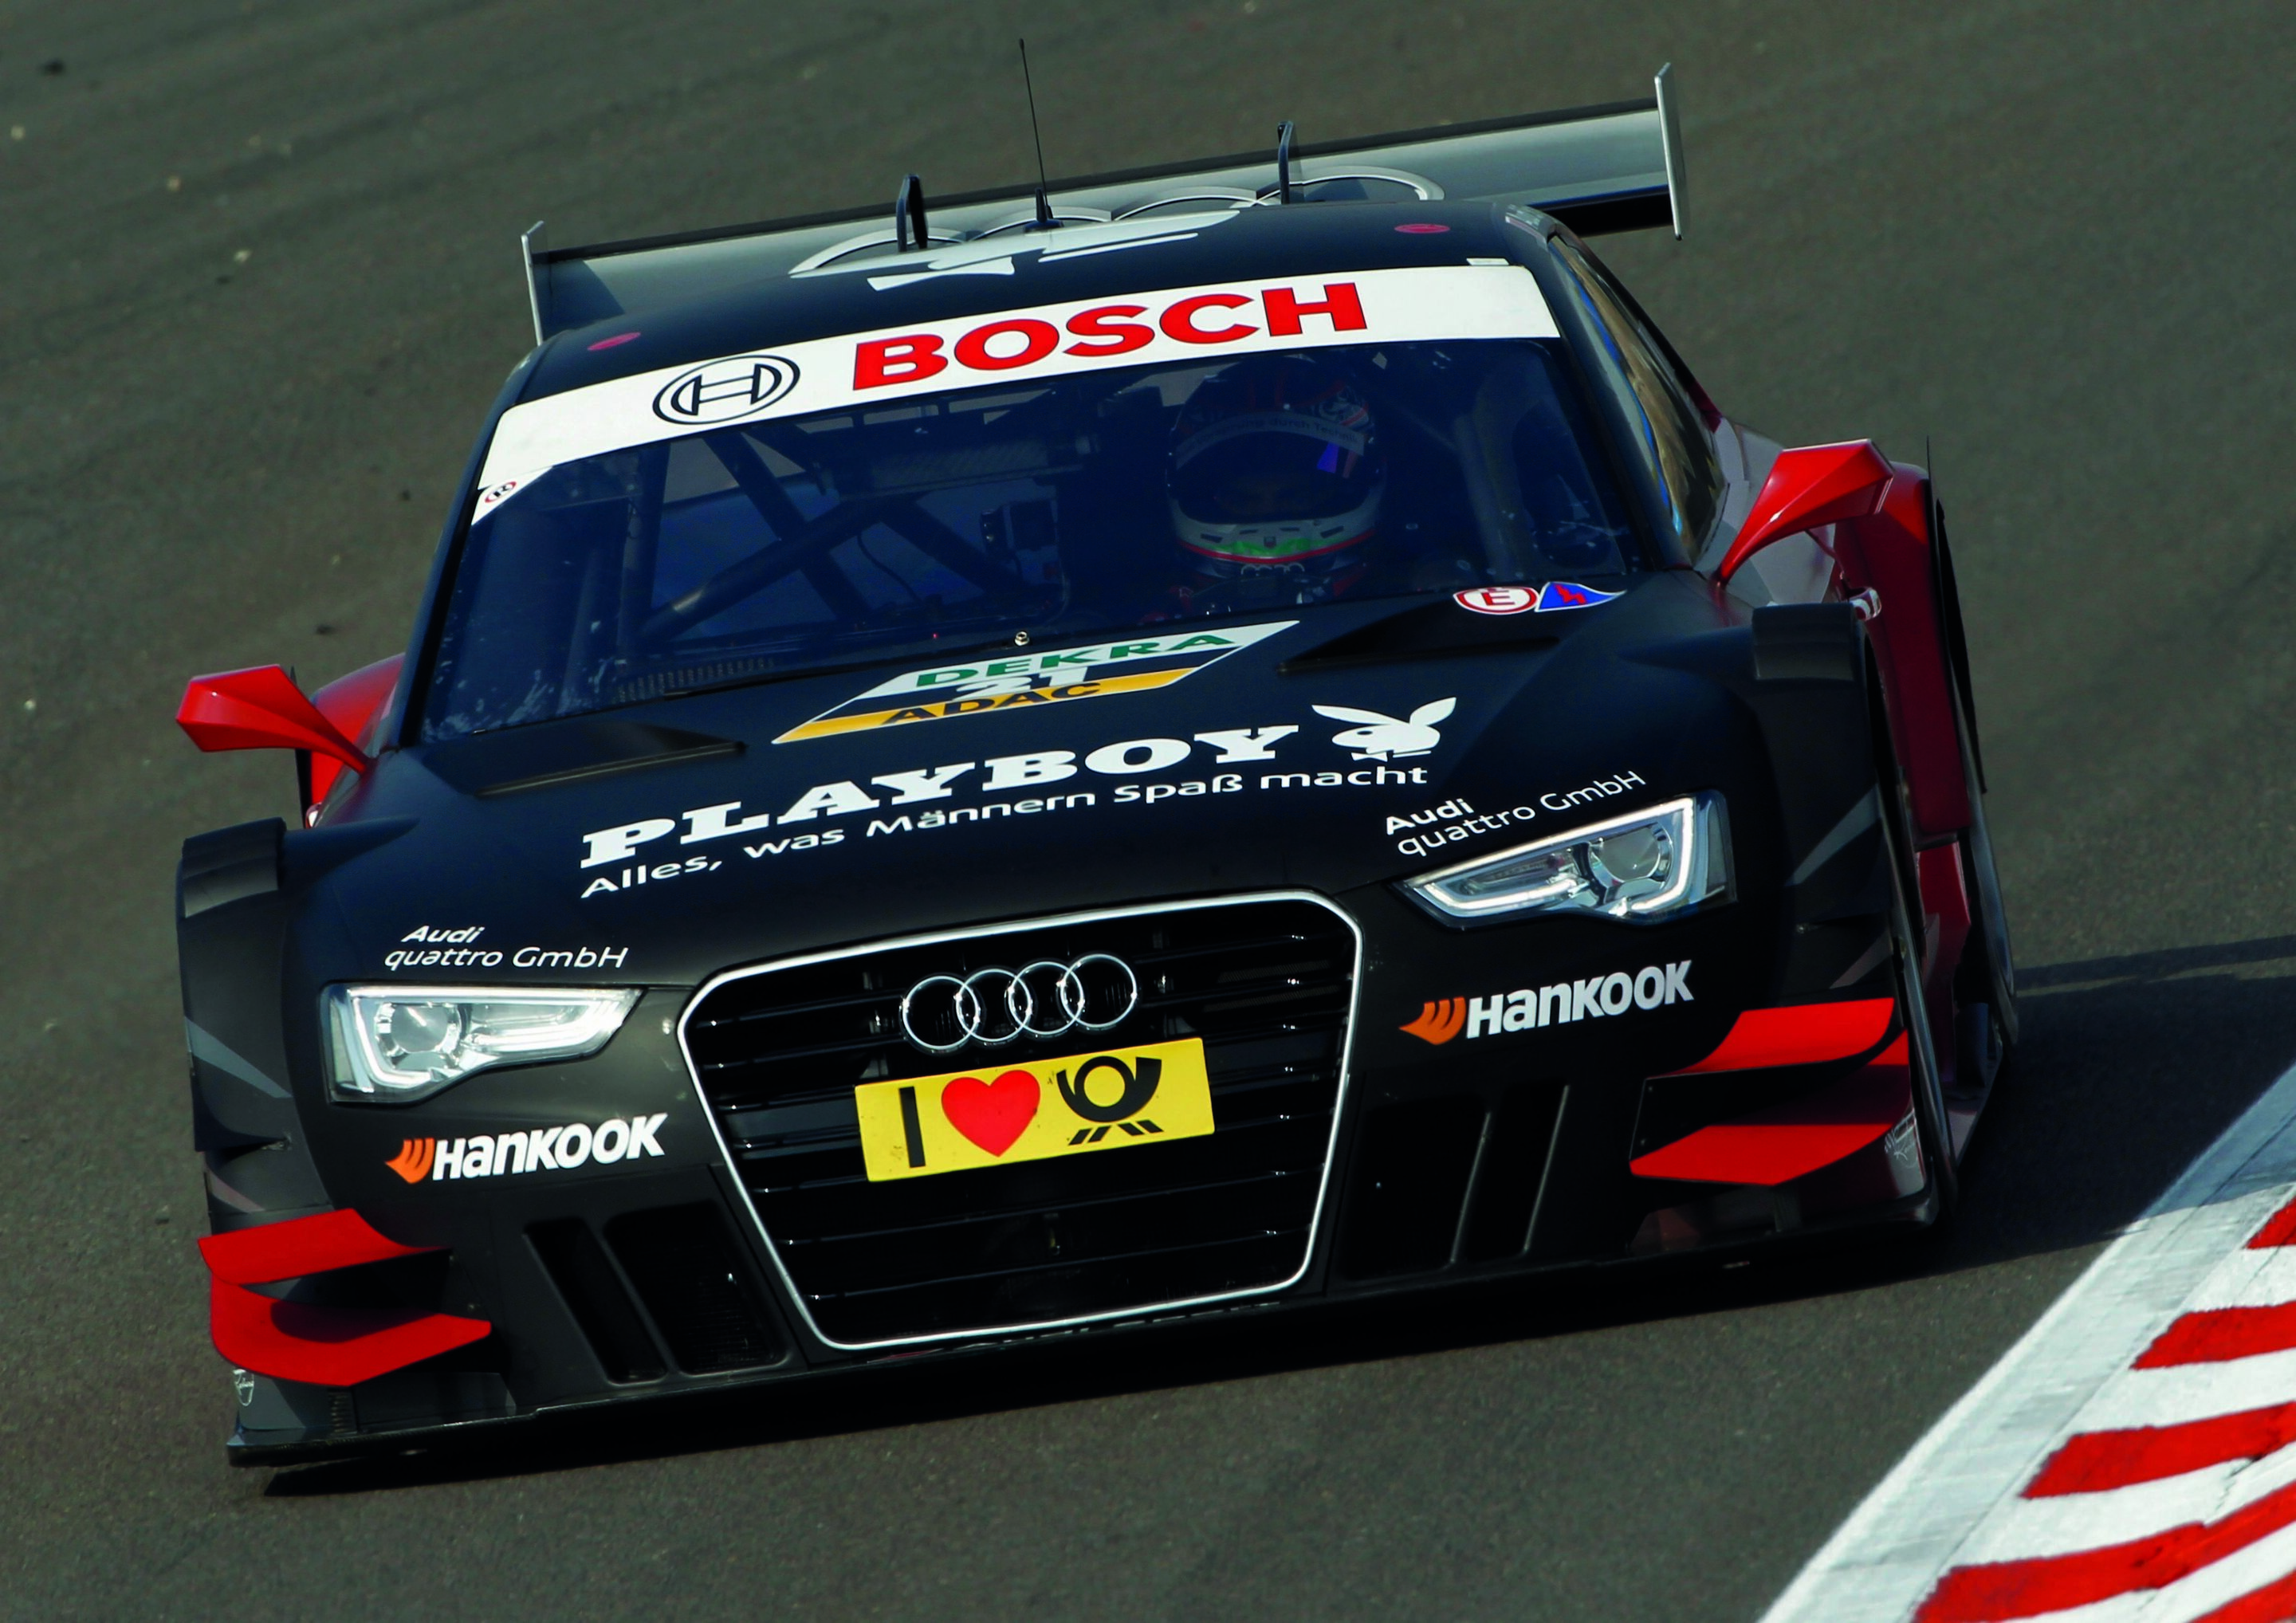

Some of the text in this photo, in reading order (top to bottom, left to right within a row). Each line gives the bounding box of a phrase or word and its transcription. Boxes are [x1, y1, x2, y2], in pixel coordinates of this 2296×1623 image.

[854, 282, 1367, 391] BOSCH
[915, 633, 1235, 690] DEKRA
[952, 666, 1088, 701] 21
[881, 682, 1101, 725] ADAC
[580, 725, 1299, 869] PLAYBOY
[1386, 798, 1474, 835] Audi
[1398, 770, 1646, 857] quattro GmbH
[581, 766, 1428, 898] Alles, was Männern Spaß macht
[384, 946, 629, 971] quattro GmbH
[401, 925, 486, 943] Audi
